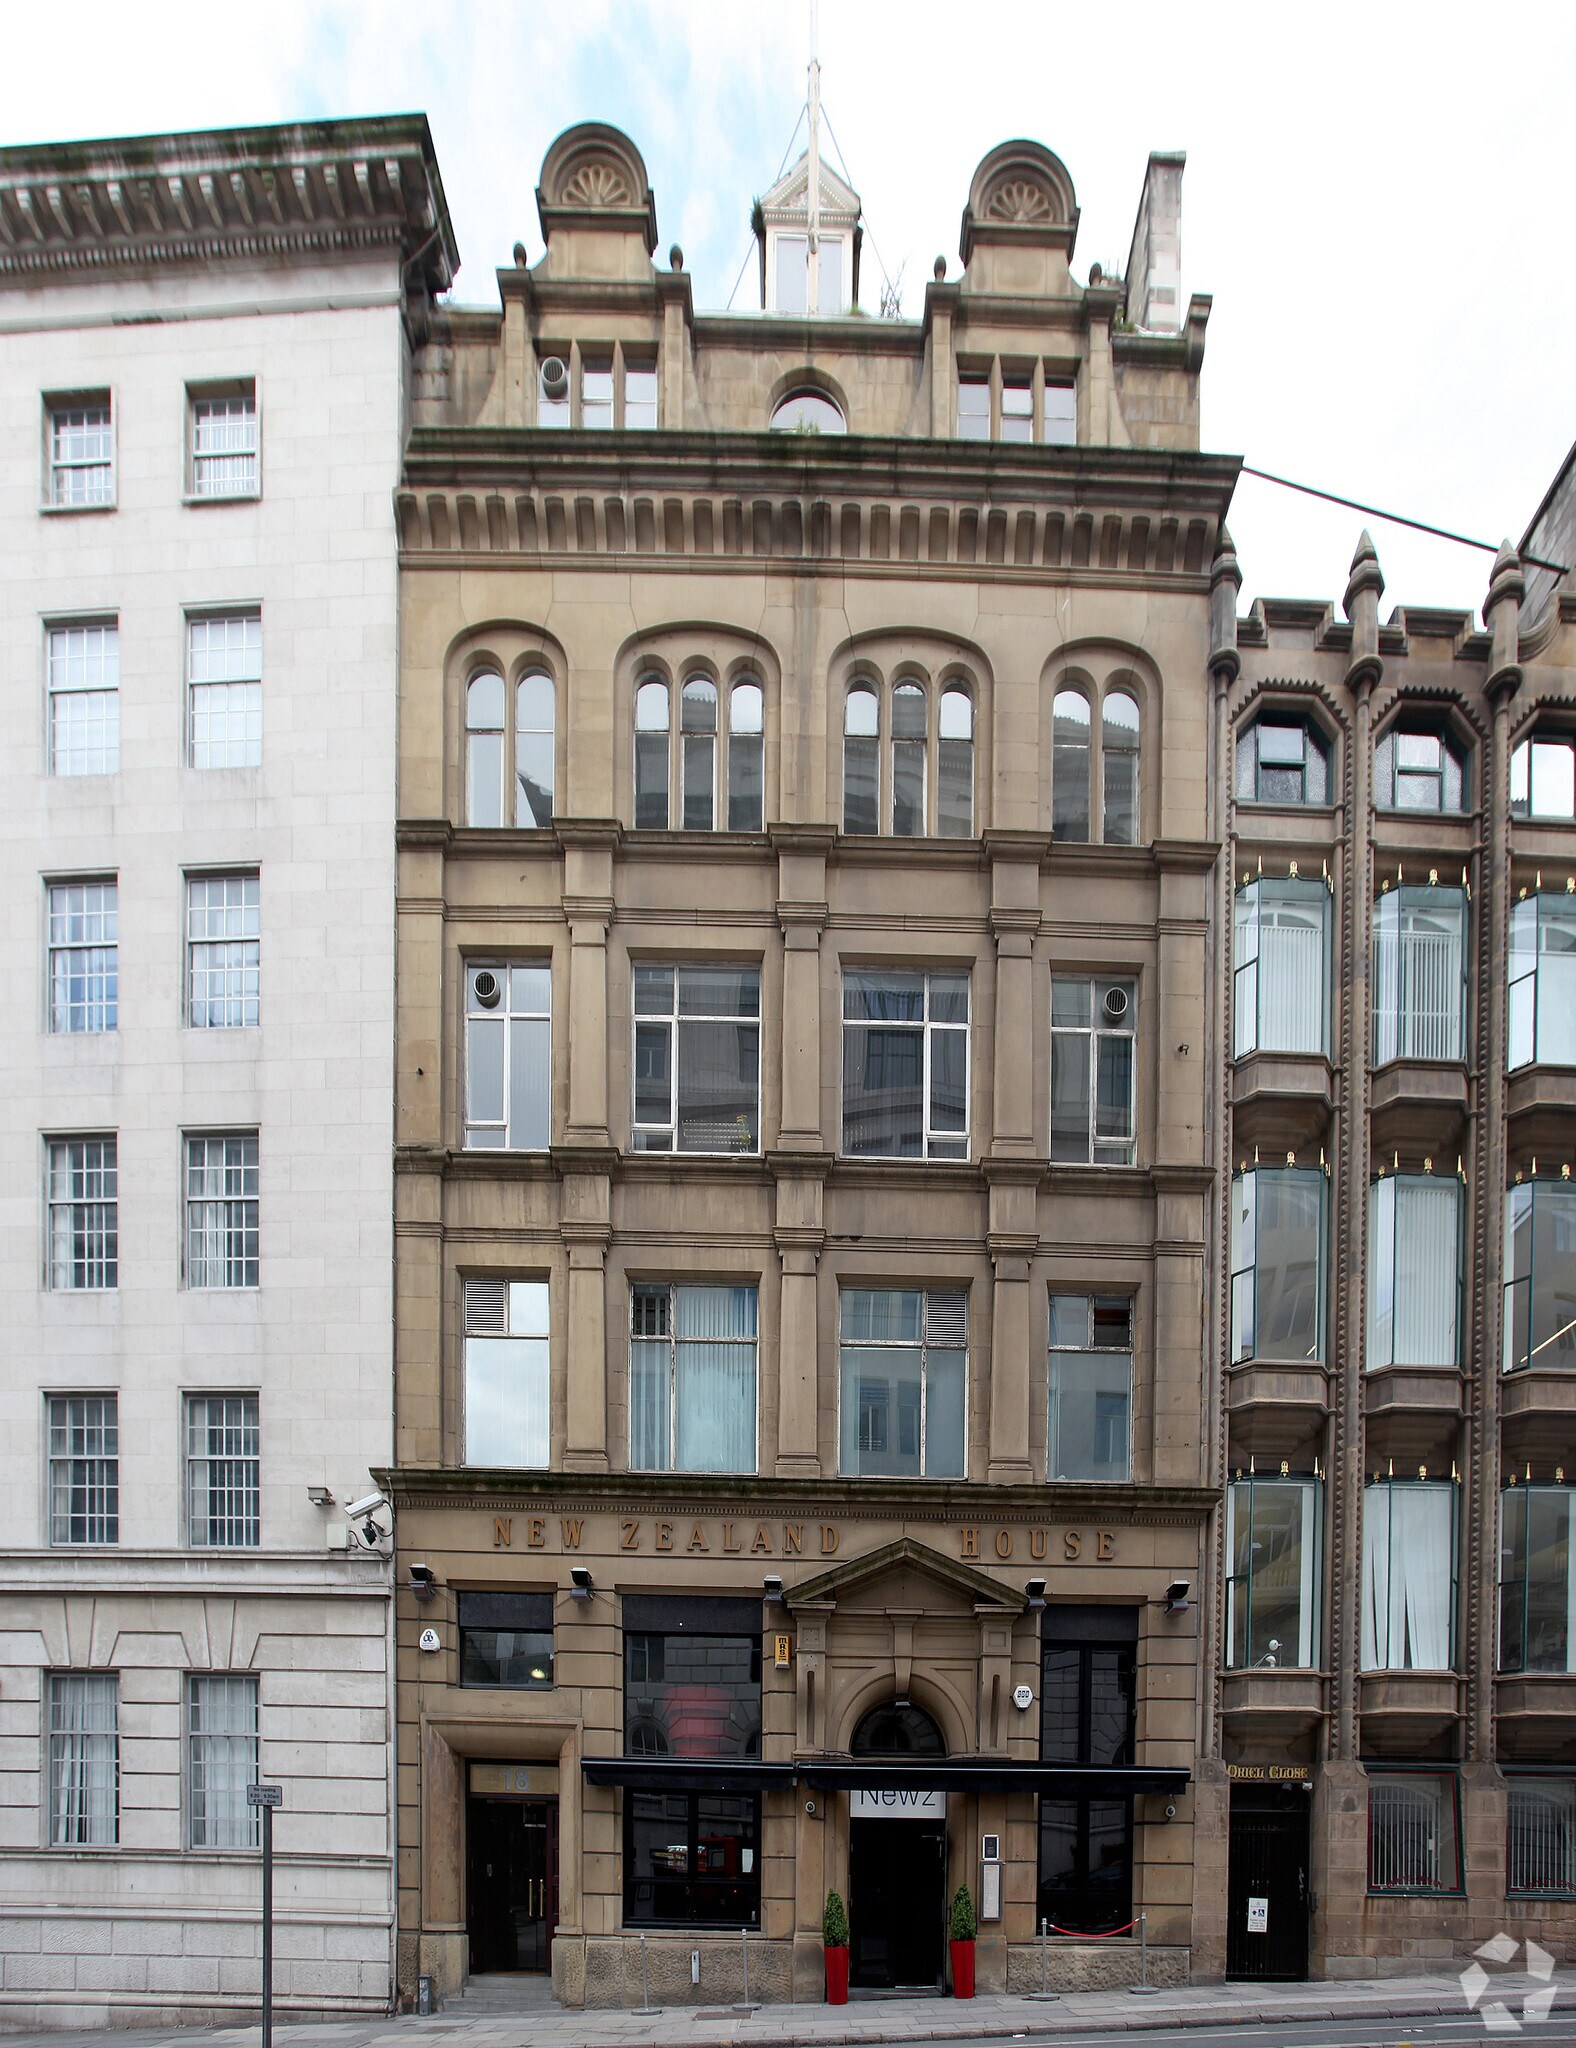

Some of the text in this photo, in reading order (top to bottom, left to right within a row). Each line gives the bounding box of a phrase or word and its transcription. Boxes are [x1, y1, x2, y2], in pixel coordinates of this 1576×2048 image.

[493, 1516, 1115, 1560] NEW ZEALAND HOUSE
[501, 1767, 530, 1792] 18
